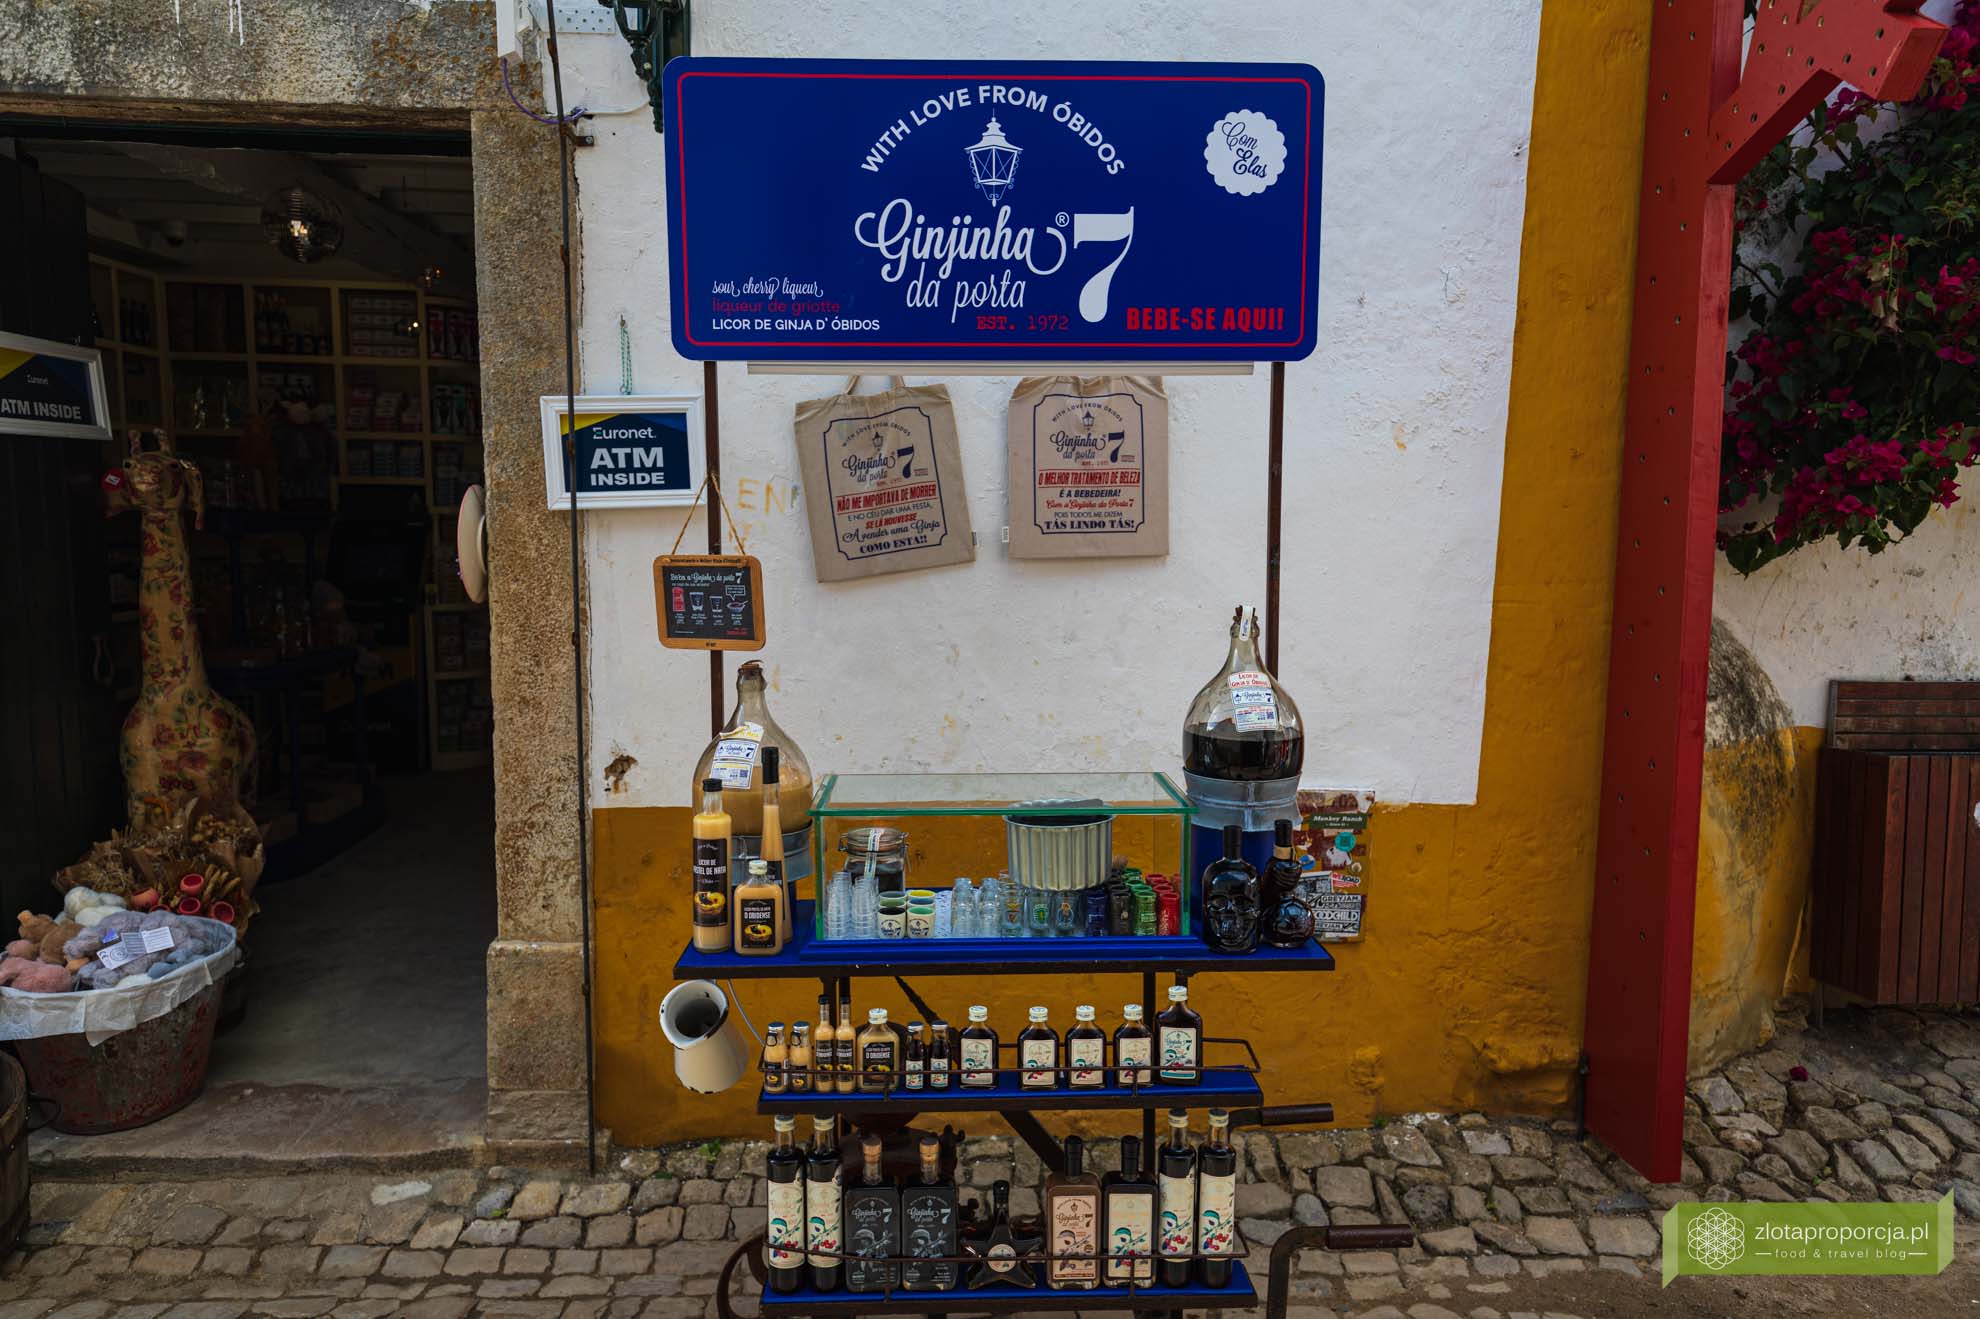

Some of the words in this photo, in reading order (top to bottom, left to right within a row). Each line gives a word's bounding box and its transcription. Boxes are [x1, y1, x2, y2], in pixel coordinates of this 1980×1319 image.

[861, 119, 911, 173] WITH
[909, 88, 971, 126] LOVE
[978, 85, 1048, 112] FROM
[1052, 101, 1125, 175] ÓBIDOS
[1222, 122, 1258, 151] Com
[1232, 148, 1267, 178] Elas
[1074, 206, 1134, 323] 7
[712, 280, 741, 297] sour
[743, 277, 780, 300] cherry
[782, 277, 824, 300] liqueur
[906, 261, 940, 307] da
[951, 269, 1026, 323] porta
[712, 298, 762, 316] liqueur
[768, 298, 787, 312] de
[791, 298, 840, 316] griotte
[712, 318, 751, 331] LICOR
[754, 318, 772, 331] DE
[775, 318, 813, 331] GINJA
[831, 316, 880, 331] ÓBIDOS
[976, 315, 1016, 331] EST.
[1028, 315, 1069, 331] 1972
[1127, 306, 1216, 331] BEBE-SE
[1222, 306, 1284, 333] AQUI!
[1, 398, 31, 416] ATM
[33, 401, 82, 420] INSIDE
[592, 427, 654, 440] Euronet
[1108, 429, 1125, 463] 7
[590, 446, 665, 469] ATM
[897, 444, 914, 478] 7
[590, 472, 665, 486] INSIDE
[1038, 472, 1043, 486] O
[1044, 472, 1070, 485] MELHOR
[1070, 472, 1109, 485] TRATAMENTO
[1110, 472, 1119, 484] DE
[1119, 472, 1140, 484] BELEZA
[837, 497, 850, 512] NÃO
[851, 496, 862, 509] ME
[863, 489, 900, 508] IMPORTAVA
[900, 488, 909, 500] DE
[910, 484, 937, 499] MORRER
[1074, 489, 1121, 497] BEBEDEIRA!
[881, 508, 895, 517] DAR
[896, 506, 913, 514] UMA
[865, 521, 874, 529] SE
[1044, 519, 1067, 529] TÁS
[1070, 520, 1106, 529] LINDO
[1108, 518, 1135, 529] TÁS!
[860, 542, 890, 553] COMO
[882, 1208, 892, 1223] 7
[941, 1208, 951, 1224] 7
[1085, 1214, 1093, 1227] 7
